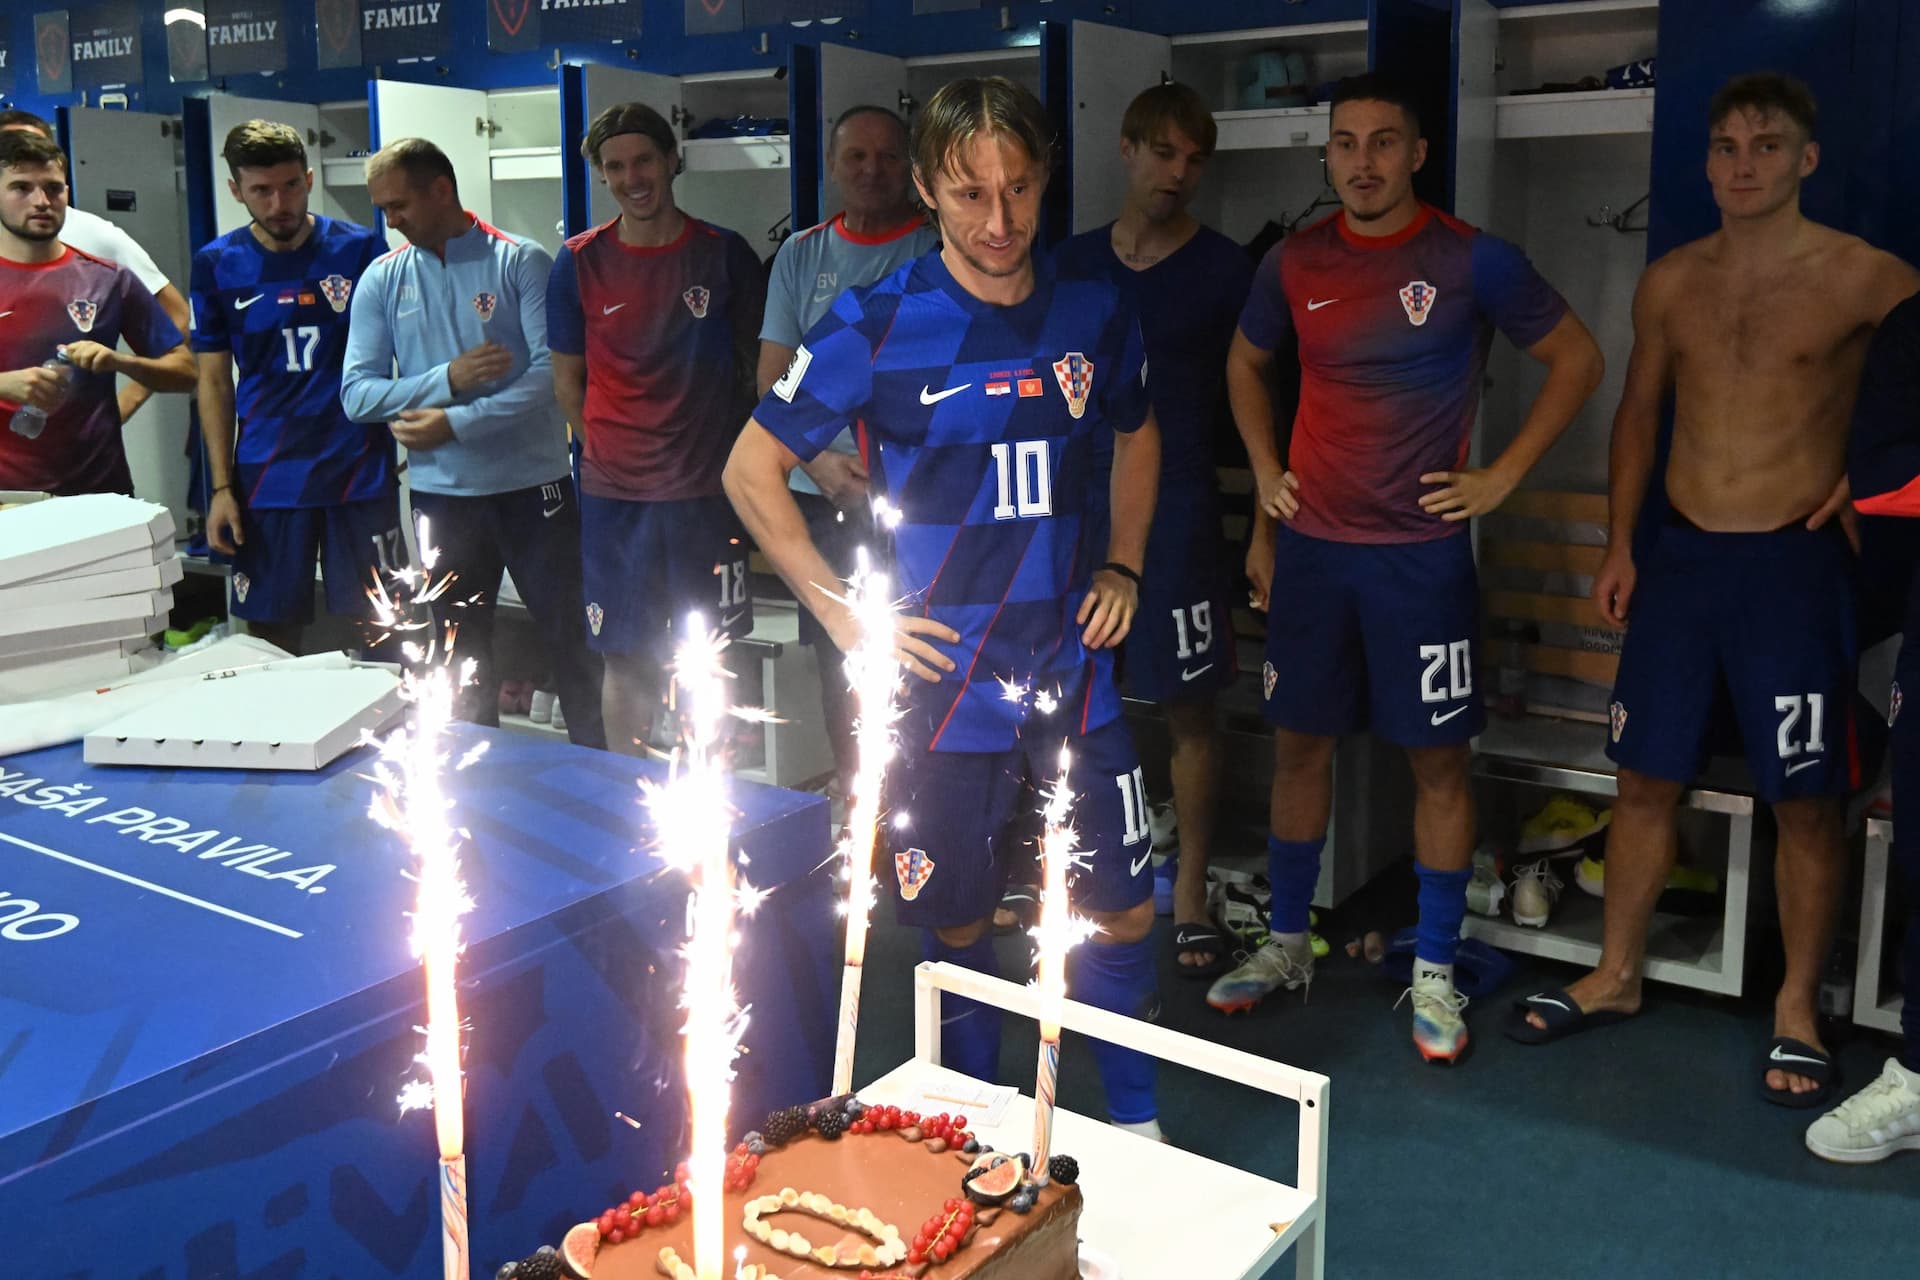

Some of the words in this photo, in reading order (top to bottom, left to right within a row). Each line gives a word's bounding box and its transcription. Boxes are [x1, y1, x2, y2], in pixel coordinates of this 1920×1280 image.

[208, 20, 278, 46] FAMILY
[363, 2, 441, 31] FAMILY
[73, 36, 133, 61] FAMILY
[282, 325, 321, 372] 17
[991, 440, 1053, 520] 10
[371, 527, 401, 573] 17
[719, 560, 747, 609] 18
[1172, 600, 1213, 659] 19
[1420, 639, 1473, 703] 20
[1775, 693, 1825, 759] 21
[85, 806, 338, 894] PRAVILA.
